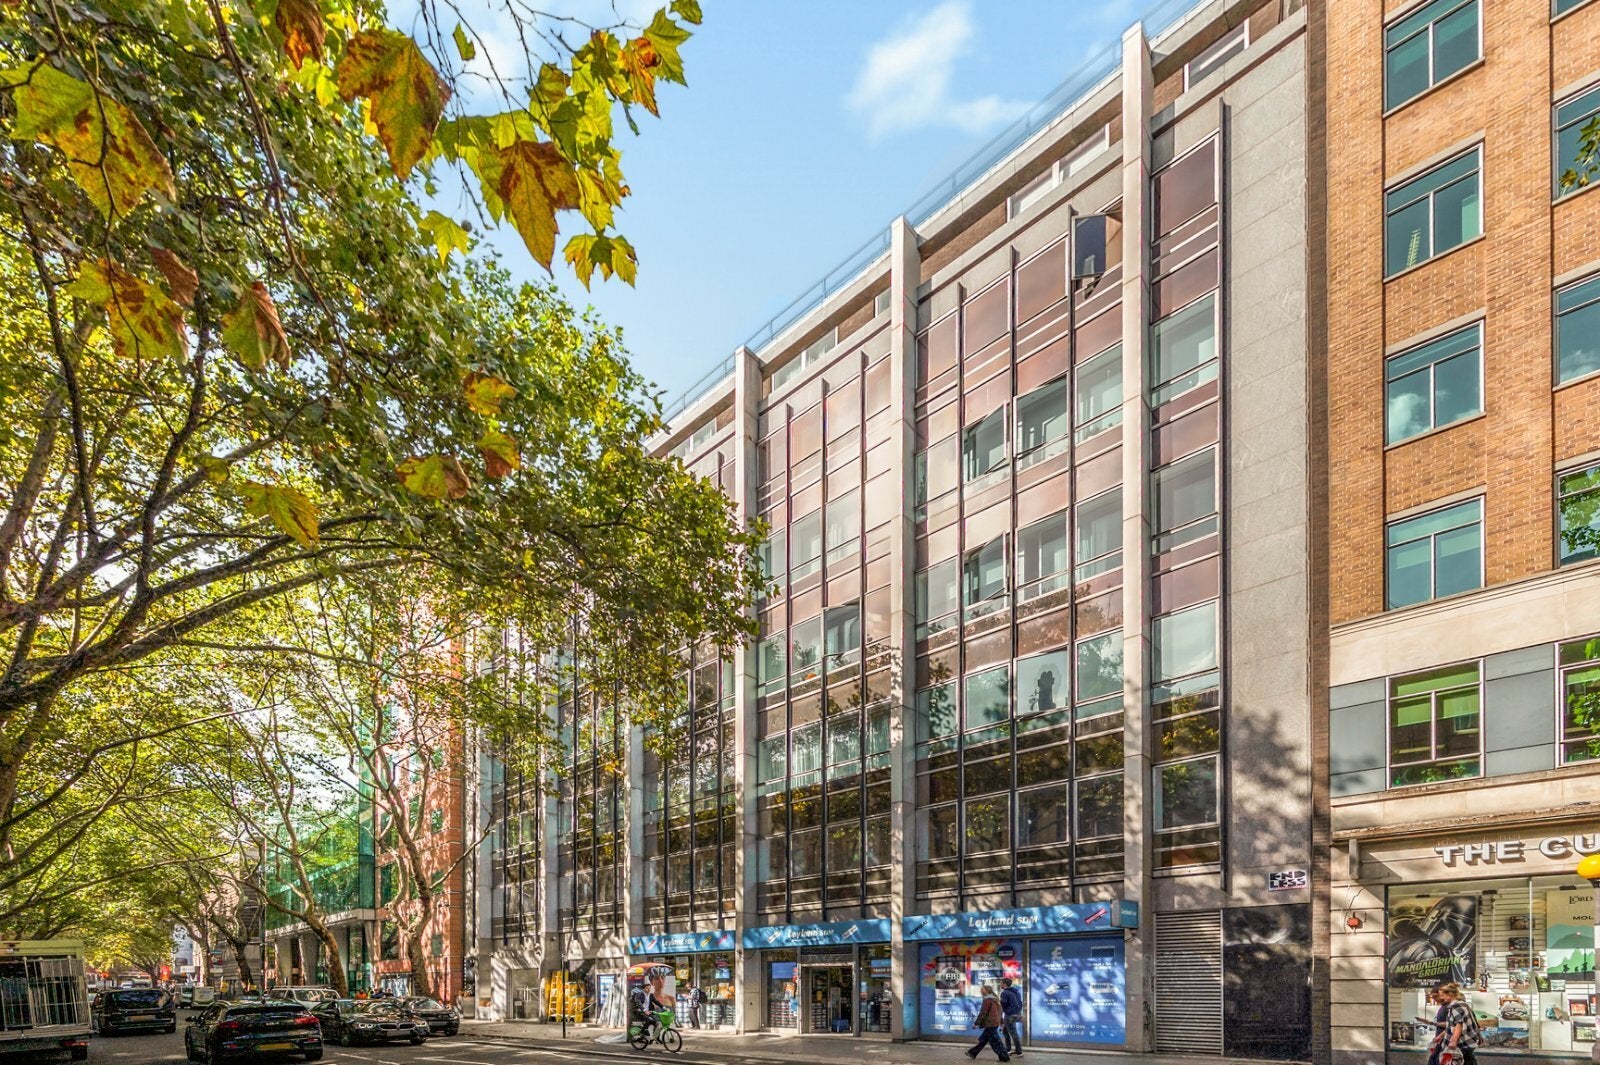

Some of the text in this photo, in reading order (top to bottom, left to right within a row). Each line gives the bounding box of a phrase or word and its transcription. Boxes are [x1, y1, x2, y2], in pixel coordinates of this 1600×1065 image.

[1434, 840, 1521, 865] THE
[969, 914, 1014, 929] Leyland
[1395, 956, 1461, 974] MANDALORIAN
[1418, 965, 1450, 978] GROGU
